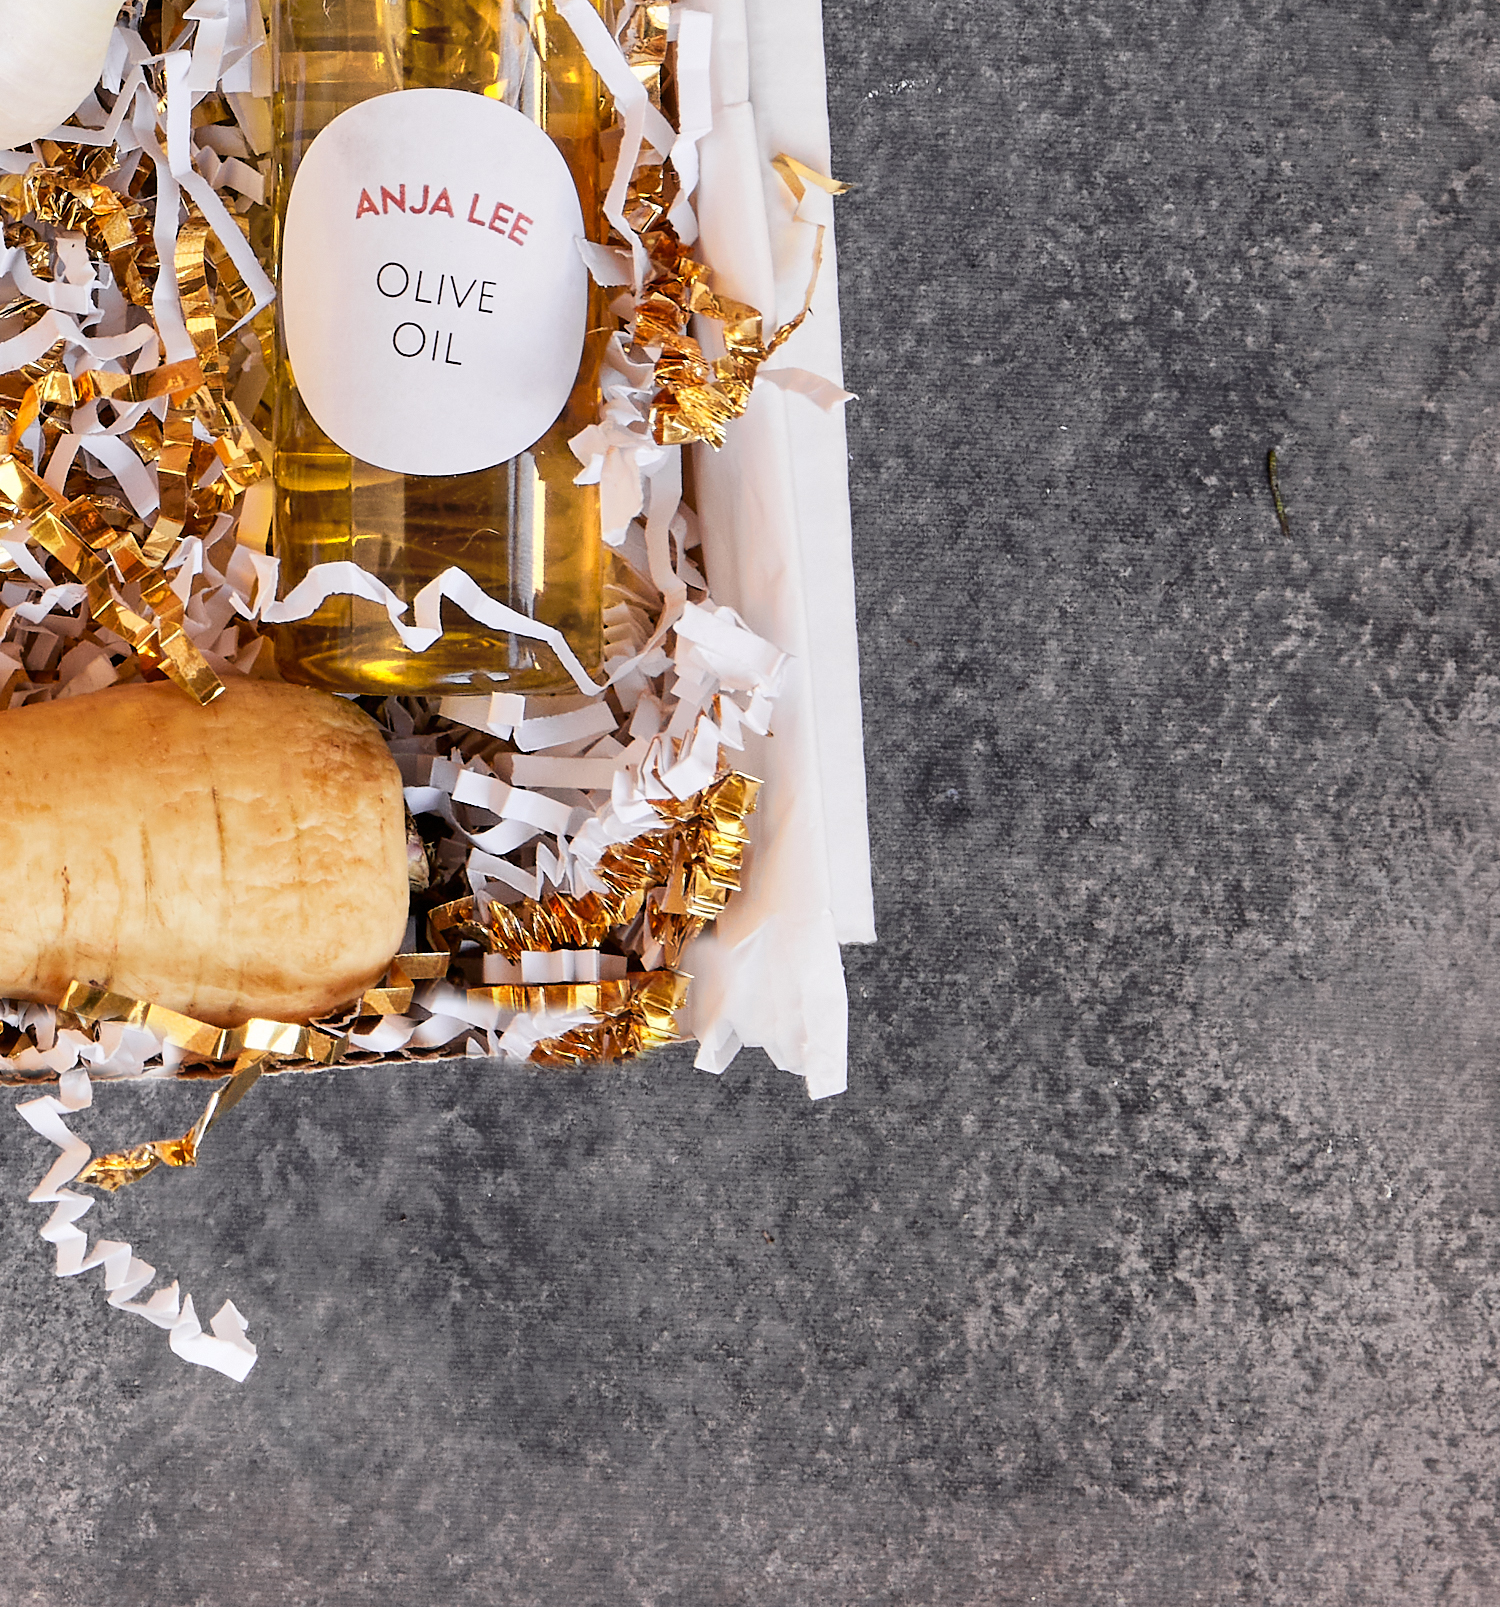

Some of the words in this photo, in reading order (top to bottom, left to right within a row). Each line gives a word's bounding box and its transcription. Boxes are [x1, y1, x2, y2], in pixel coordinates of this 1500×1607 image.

[356, 184, 454, 219] ANJA
[467, 193, 534, 246] LEE
[376, 262, 497, 313] OLIVE
[393, 322, 462, 365] OIL
